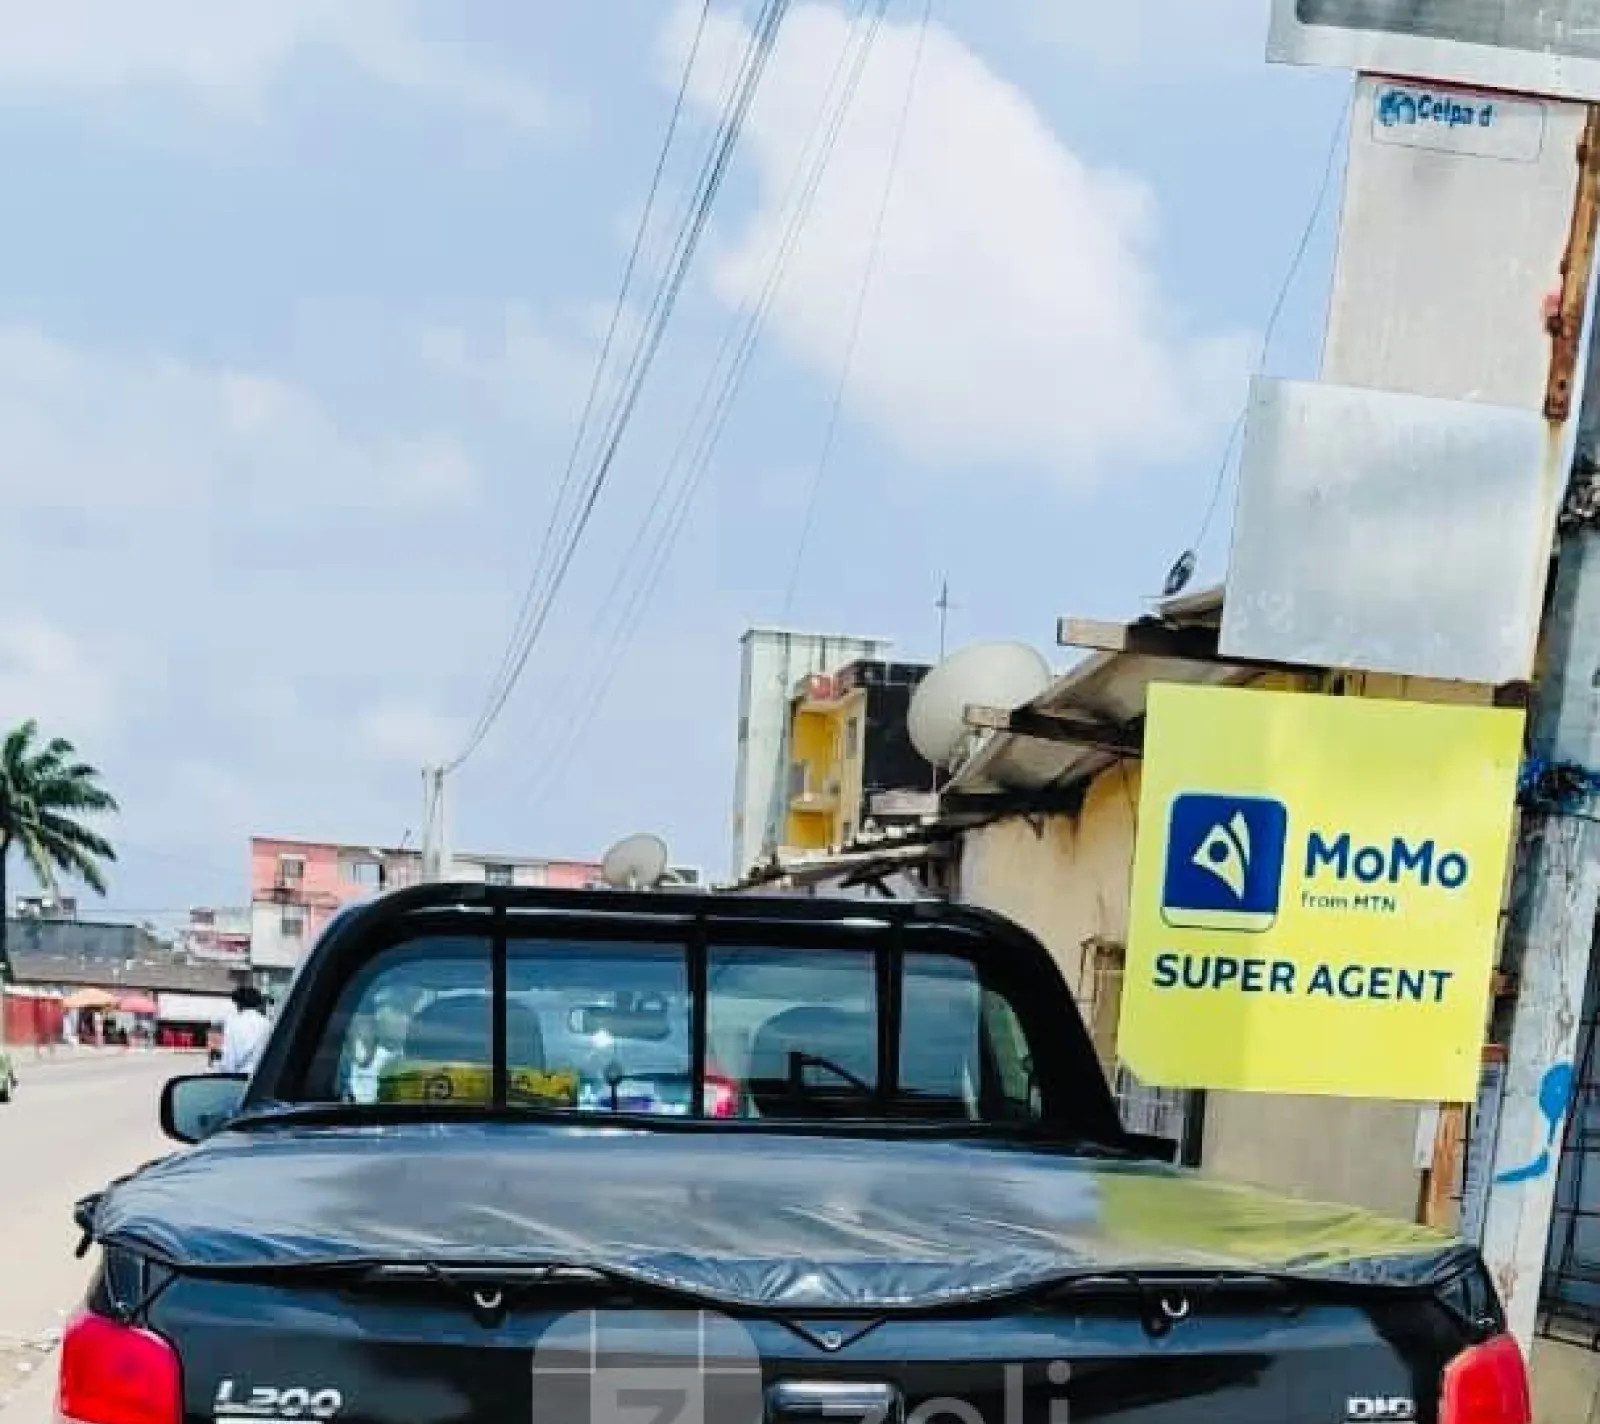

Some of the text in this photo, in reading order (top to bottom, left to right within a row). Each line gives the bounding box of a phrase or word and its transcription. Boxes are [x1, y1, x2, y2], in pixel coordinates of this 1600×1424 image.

[1417, 94, 1493, 127] Celpad
[1304, 832, 1468, 889] MoMo
[1301, 890, 1396, 913] from MTN
[1152, 953, 1453, 1003] SUPER AGENT
[213, 1380, 341, 1416] L200
